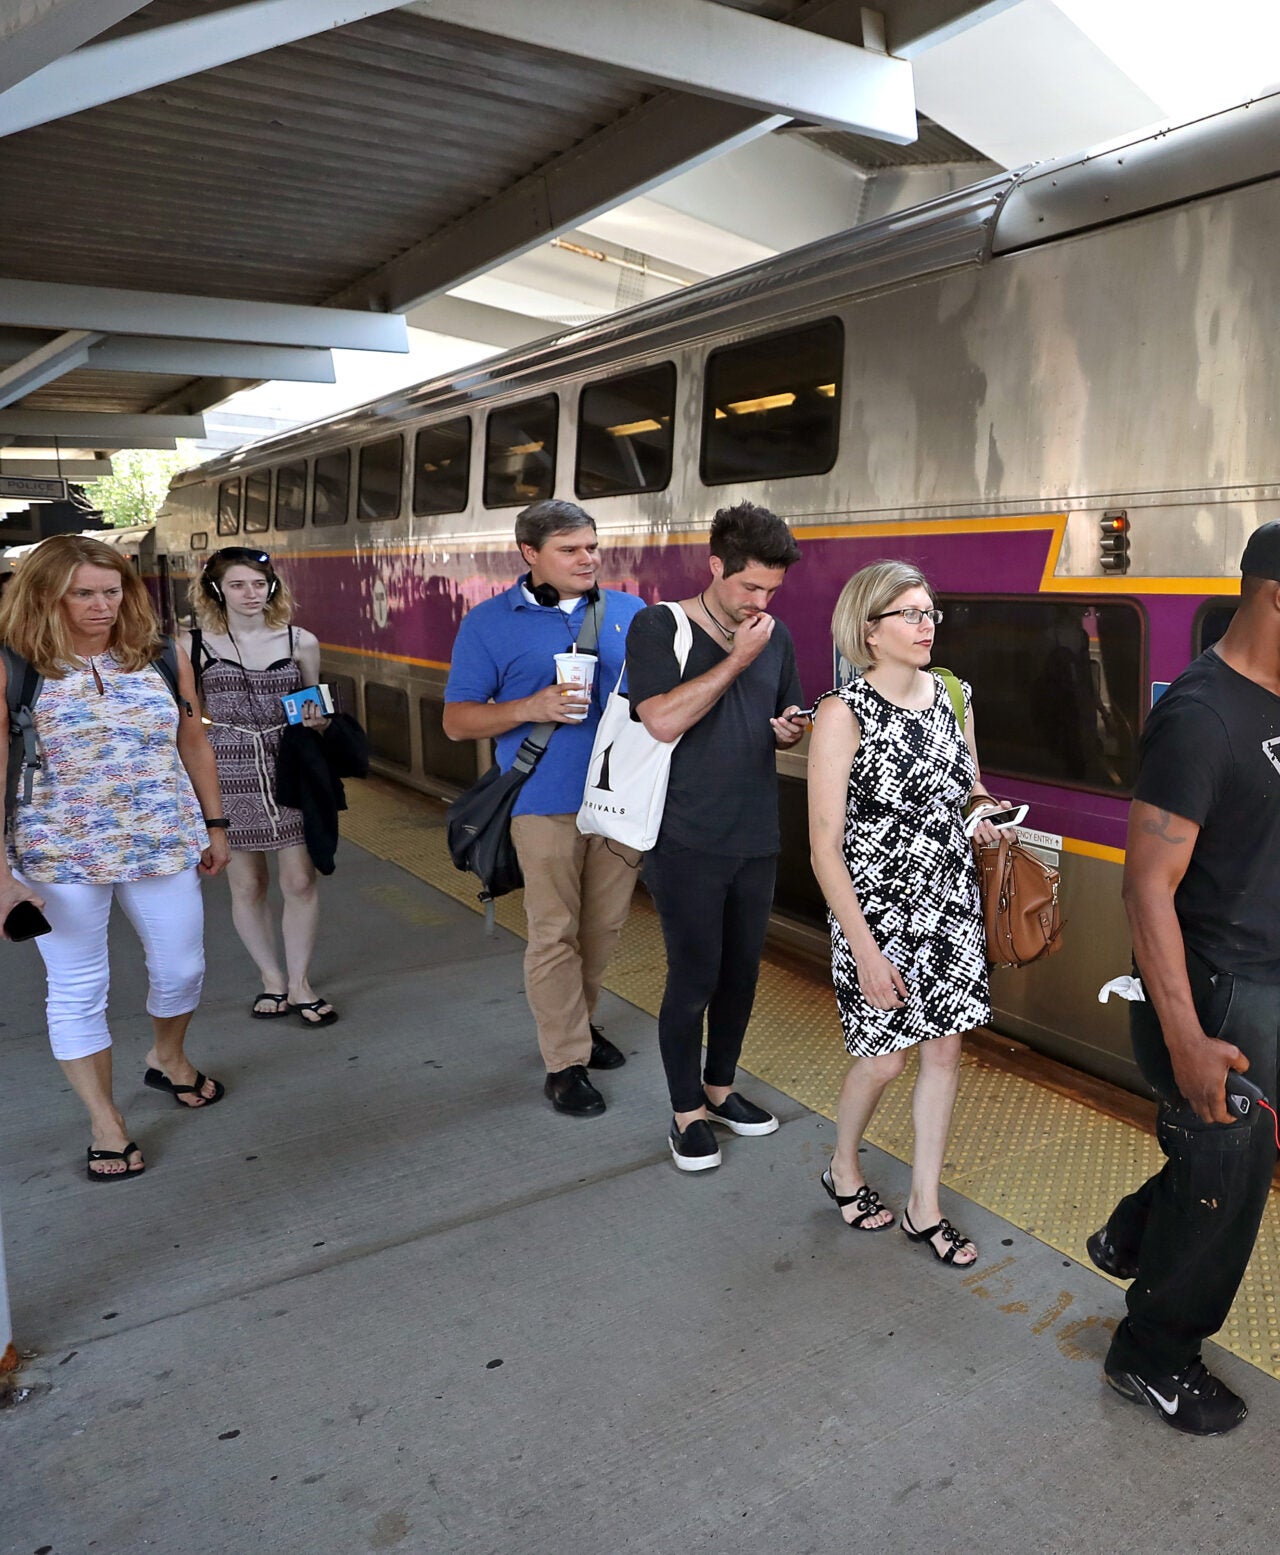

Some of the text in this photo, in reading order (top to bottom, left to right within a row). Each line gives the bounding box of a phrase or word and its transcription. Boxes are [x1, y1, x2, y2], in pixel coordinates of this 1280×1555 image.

[8, 480, 55, 491] POLICE
[1013, 829, 1054, 845] ENCY ENTRY
